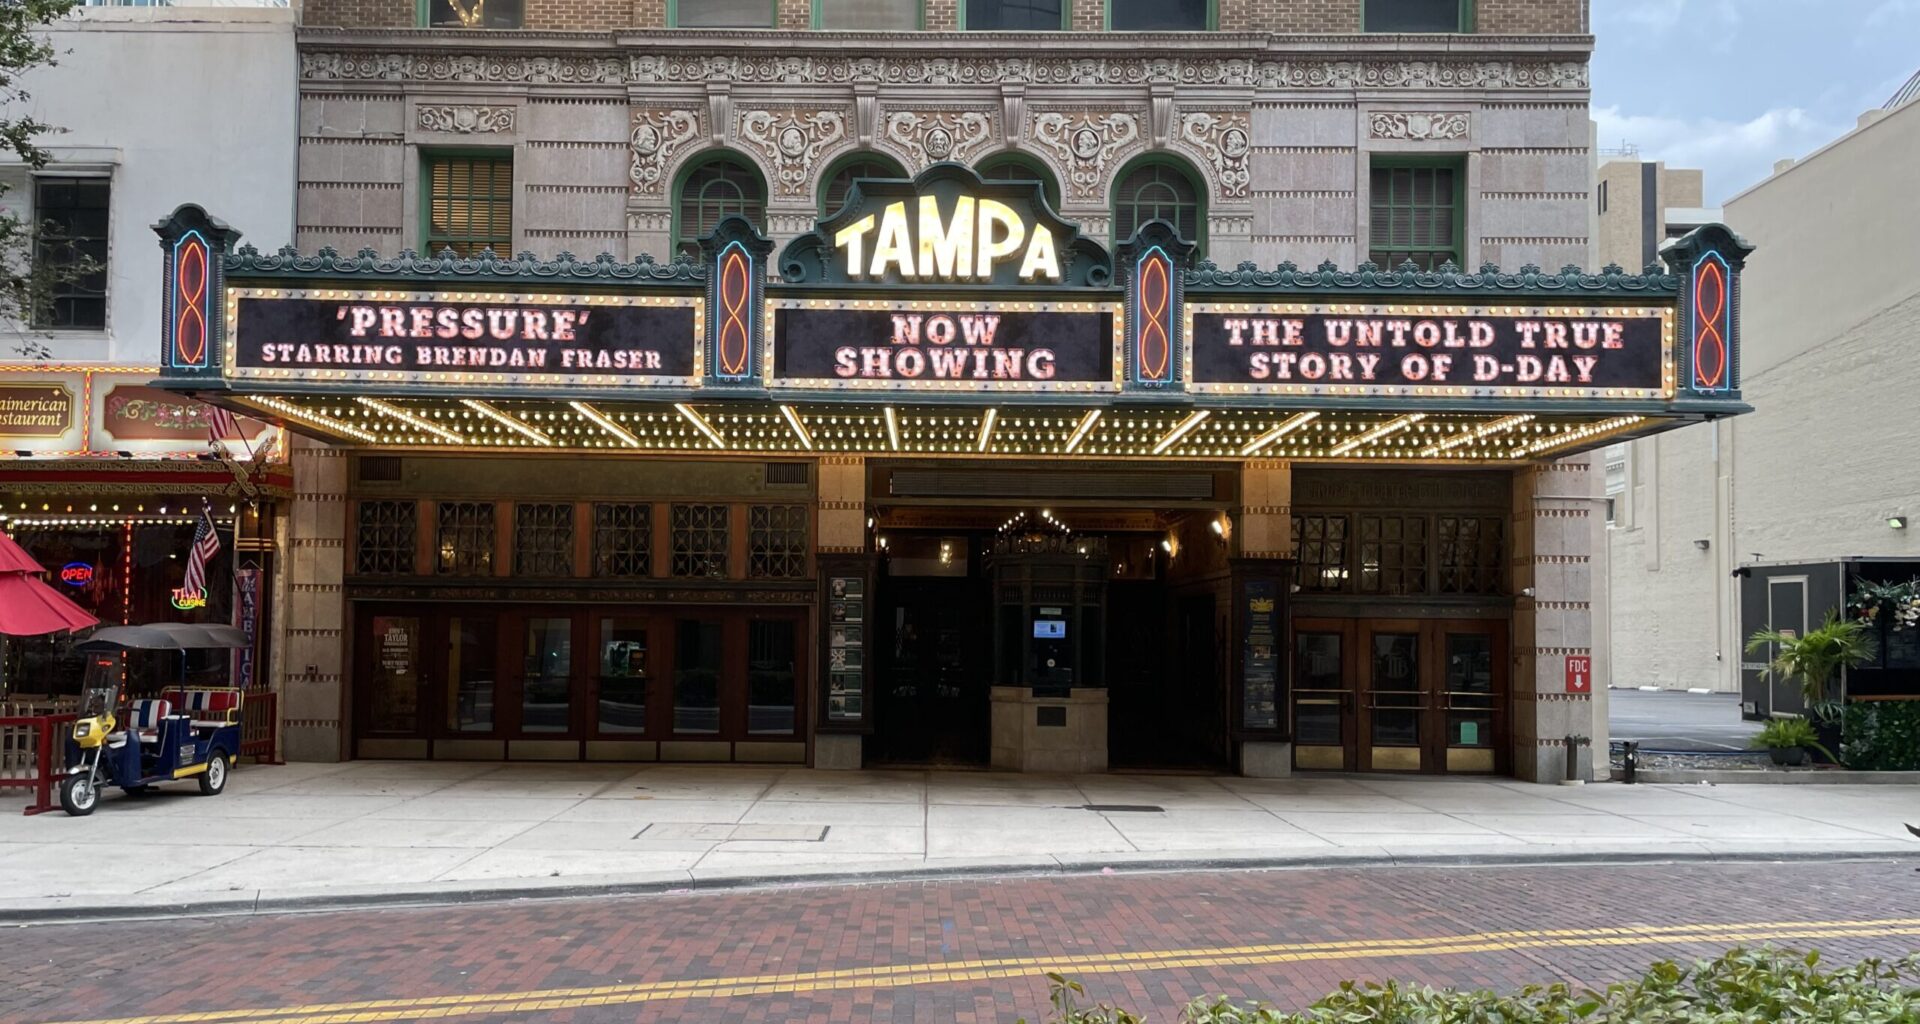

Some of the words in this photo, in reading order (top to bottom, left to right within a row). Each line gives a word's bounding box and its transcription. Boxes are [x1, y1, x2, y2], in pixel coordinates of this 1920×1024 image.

[834, 194, 1061, 278] TAMPA
[335, 305, 592, 341] 'PRESSURE'
[890, 313, 1001, 345] NOW
[1223, 317, 1305, 346] THE
[1323, 318, 1496, 348] UNTOLD
[1515, 320, 1625, 349] TRUE
[262, 343, 403, 364] STARRING
[416, 345, 547, 367] BRENDAN
[560, 348, 662, 369] FRASER
[833, 346, 1057, 380] SHOWING
[1249, 351, 1382, 380] STORY
[1400, 352, 1453, 382] OF
[1472, 353, 1599, 383] D-DAY
[0, 412, 62, 426] staurant
[61, 567, 93, 580] OPEN
[178, 599, 207, 607] CUISINE
[241, 591, 254, 690] AMEICA
[1569, 659, 1588, 672] FDC
